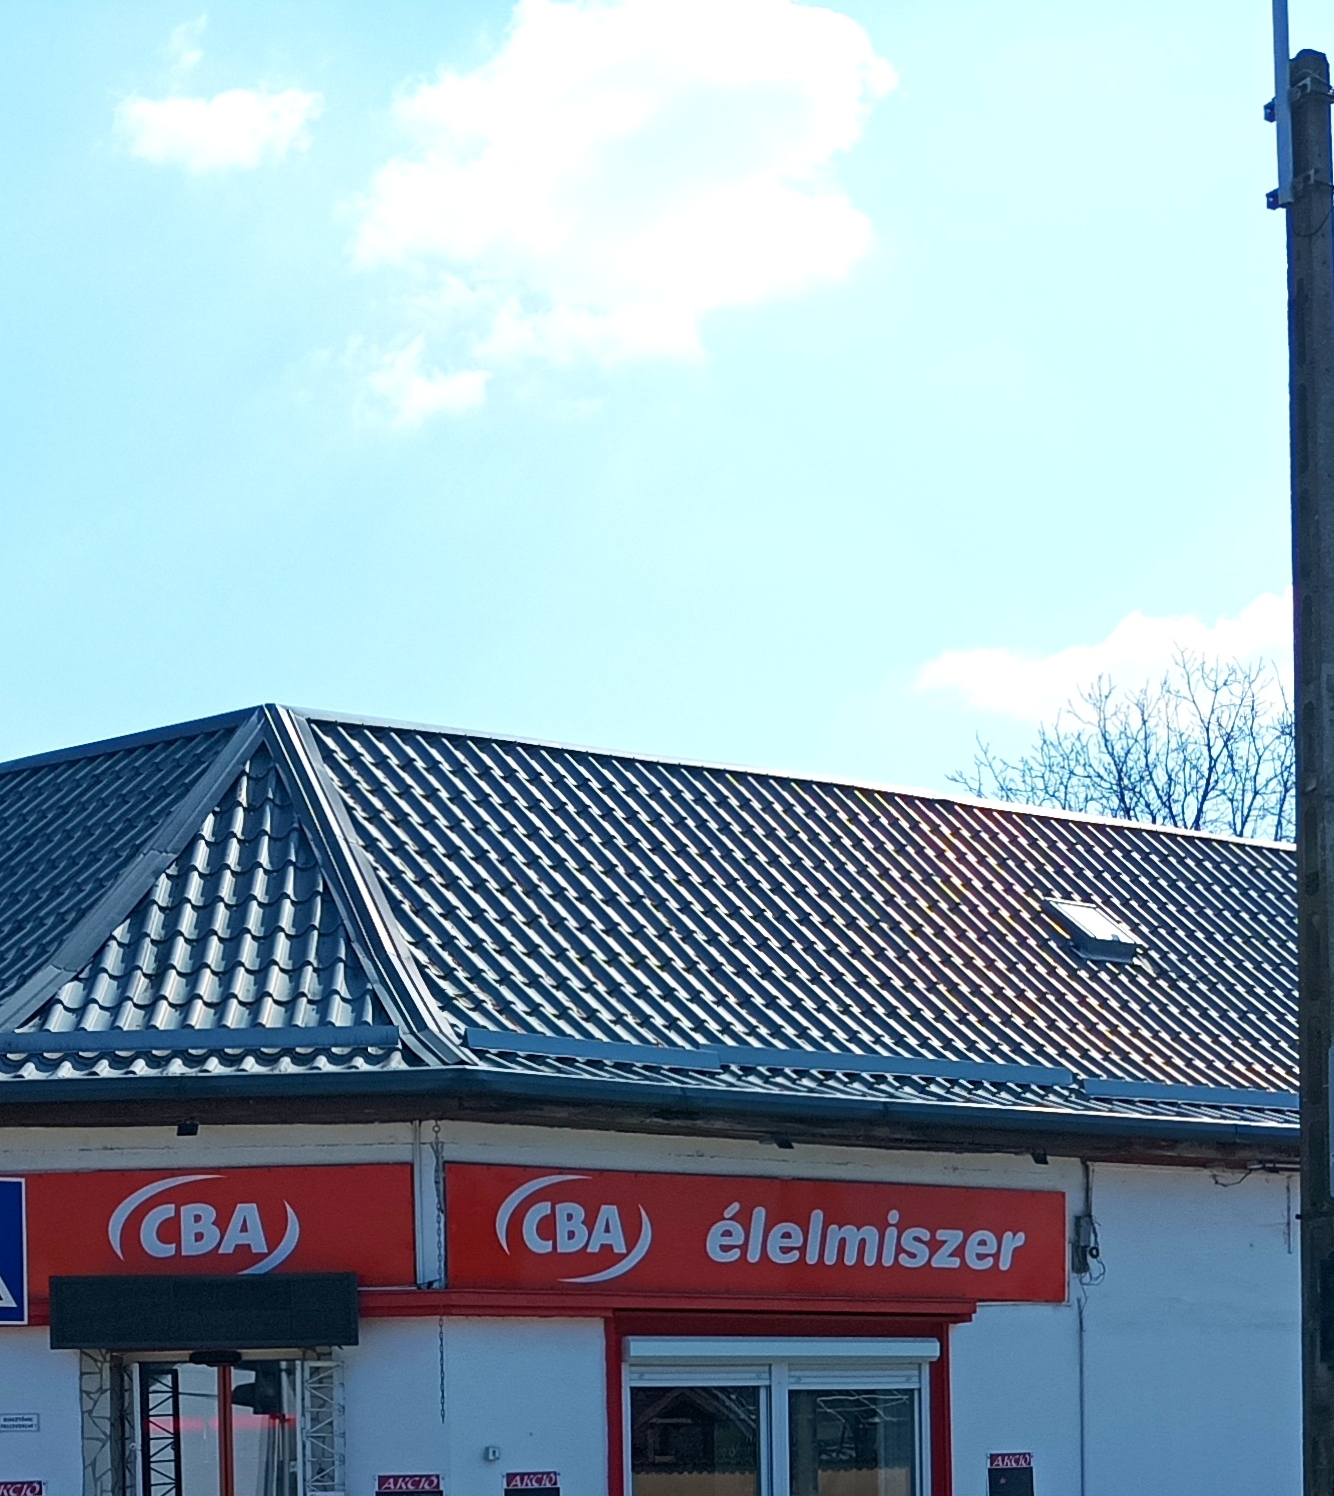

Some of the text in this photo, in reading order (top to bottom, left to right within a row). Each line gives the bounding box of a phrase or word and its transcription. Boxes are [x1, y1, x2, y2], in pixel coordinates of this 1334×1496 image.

[140, 1203, 269, 1258] CBA
[522, 1201, 1026, 1271] CBA élelmiszer
[380, 1475, 438, 1490] AKCIÓ
[508, 1473, 556, 1487] AKCIÓ
